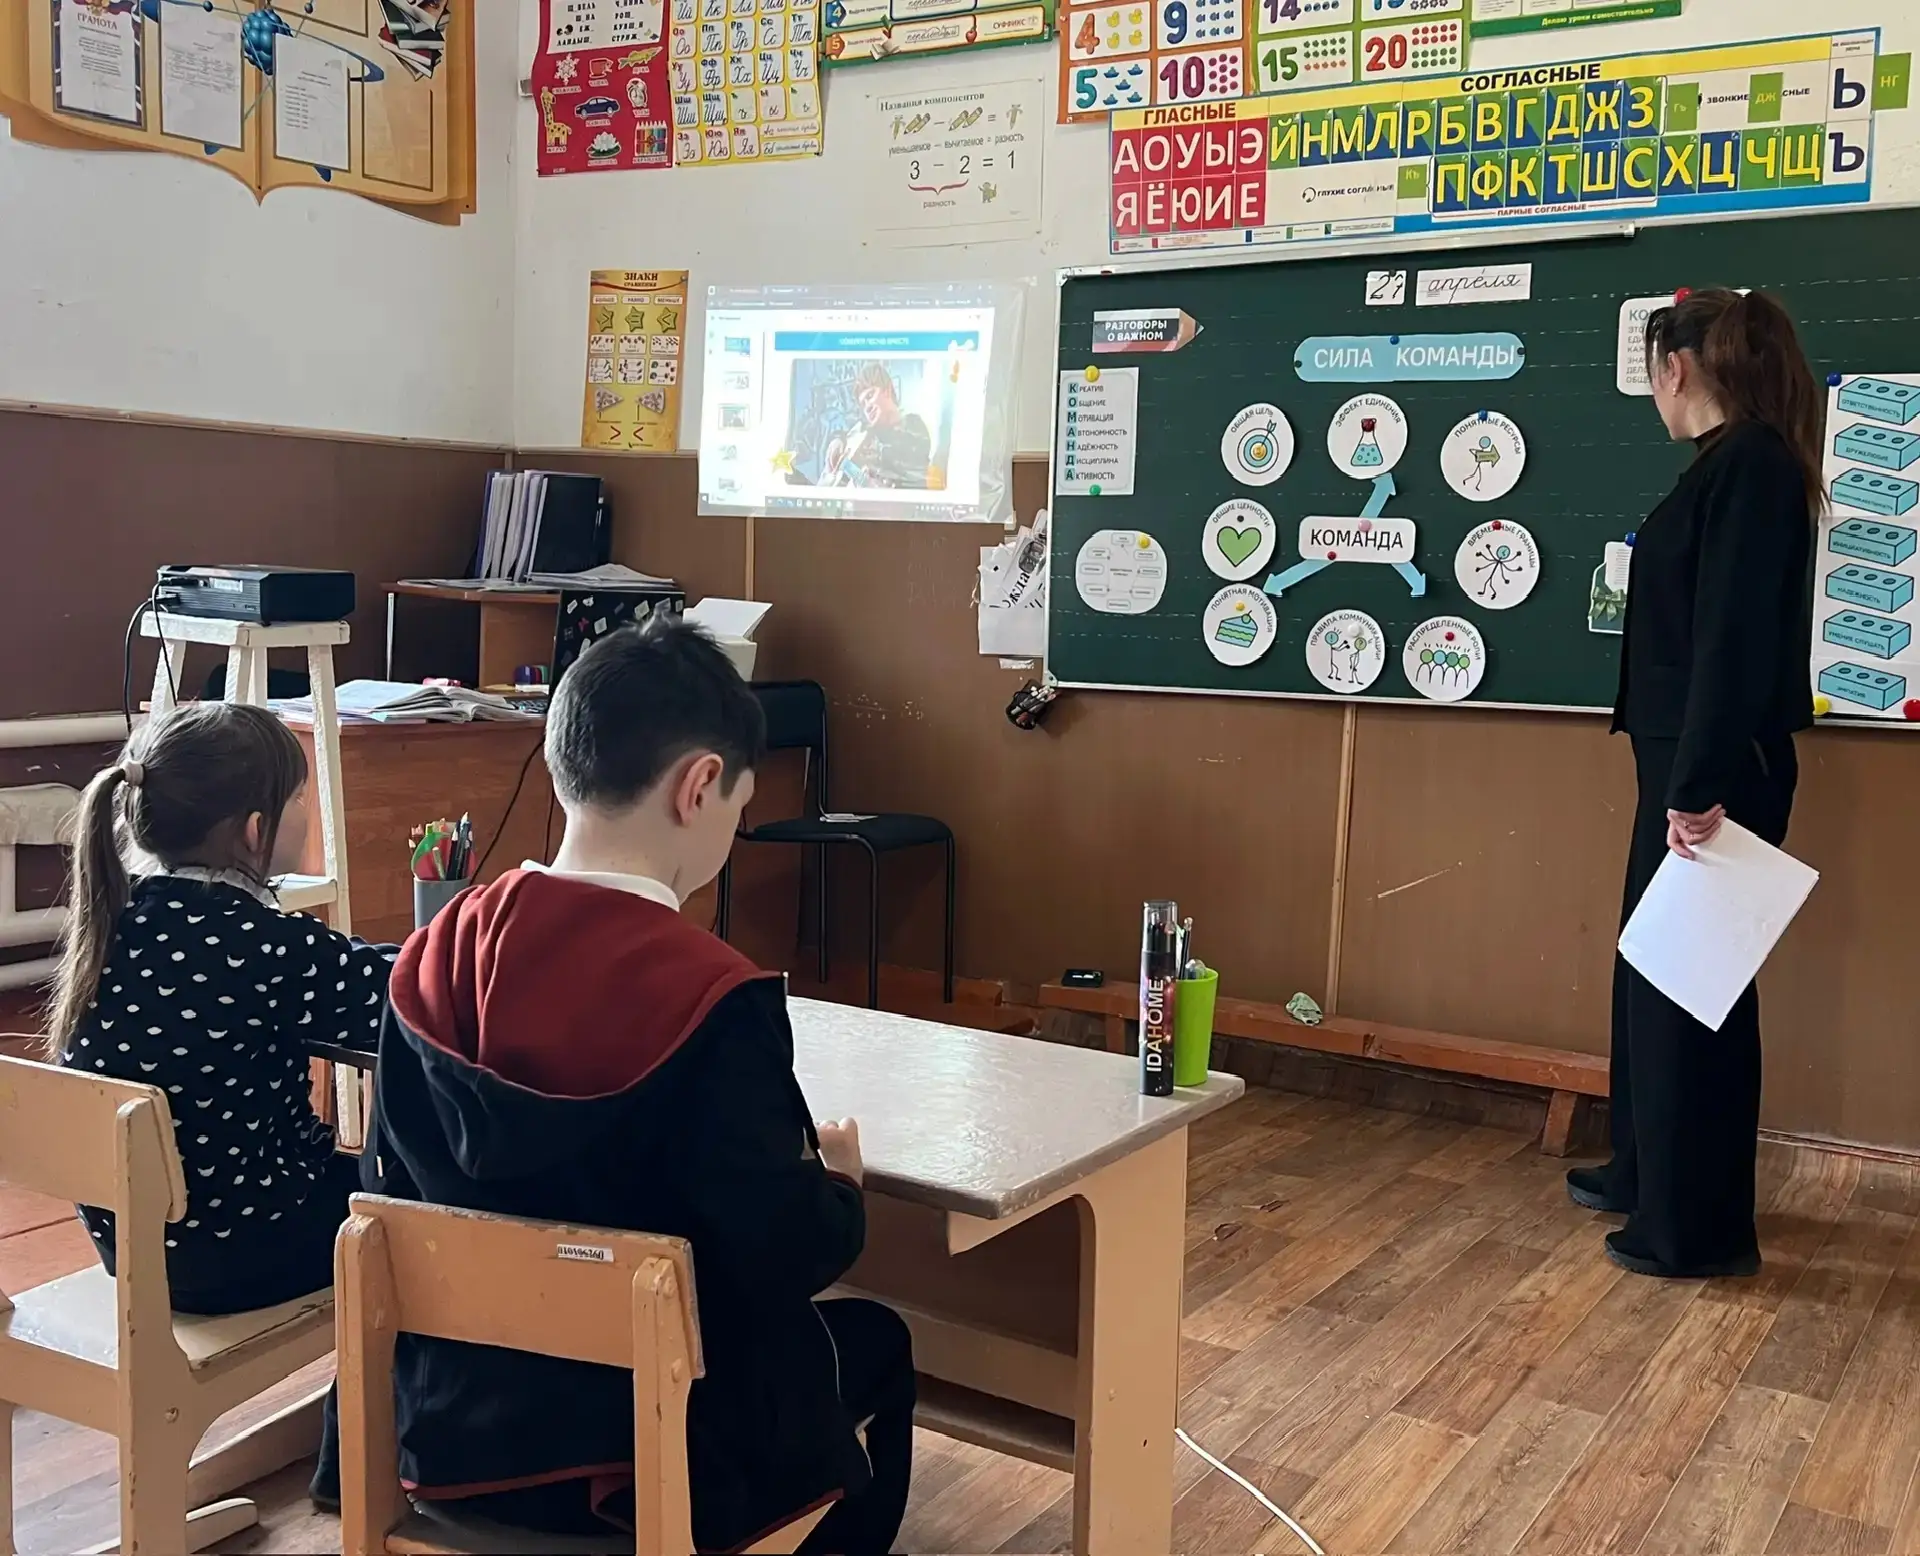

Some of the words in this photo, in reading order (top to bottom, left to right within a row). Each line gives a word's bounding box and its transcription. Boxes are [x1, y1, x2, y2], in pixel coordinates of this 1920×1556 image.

[1074, 13, 1100, 54] 4
[1165, 0, 1188, 44] 9
[832, 39, 840, 50] 5
[1365, 34, 1407, 72] 20
[1159, 56, 1205, 100] 10
[1261, 47, 1298, 82] 15
[1461, 63, 1601, 92] СОГЛАСНЫЕ
[1075, 68, 1099, 109] 5
[1833, 67, 1866, 110] Ь
[1880, 74, 1900, 88] НГ
[1754, 92, 1777, 104] ДЖ
[1143, 102, 1236, 125] ГЛАСНЫЕ
[910, 160, 920, 180] 3
[959, 156, 970, 174] 2
[1008, 150, 1014, 169] 1
[1498, 208, 1532, 216] ПАРНЫЕ
[1534, 204, 1586, 214] СОГЛАСНЫЕ
[624, 272, 658, 281] ЗНАКИ
[1105, 320, 1167, 330] РАЗГОВОРЫ
[1108, 332, 1116, 342] О
[1117, 331, 1164, 341] ВАЖНОМ
[1314, 348, 1373, 368] СИЛА
[1396, 344, 1515, 369] КОМАНДЫ
[1230, 409, 1255, 433] ОБЩАЯ
[1335, 399, 1363, 428] ЭФФЕКТ
[1365, 398, 1402, 424] ЕДИНЕНИЯ
[1500, 421, 1521, 455] РЕСУРСЫ
[1212, 503, 1236, 524] ОБЩИЕ
[1237, 502, 1270, 528] ЦЕННОСТИ
[1310, 528, 1404, 551] КОМАНДА
[1516, 529, 1536, 568] ГРАНИЦЫ
[1211, 588, 1247, 611] ПОНЯТНАЯ
[1248, 590, 1274, 633] МОТИВАЦИЯ
[1310, 616, 1338, 646] ПРАВИЛА
[1338, 613, 1381, 661] КОММУНИКАЦИИ
[1407, 619, 1472, 651] РАСПРЕДЕЛЕННЫЕ
[1470, 636, 1481, 660] РОЛИ
[1146, 978, 1164, 1072] IDAHOME
